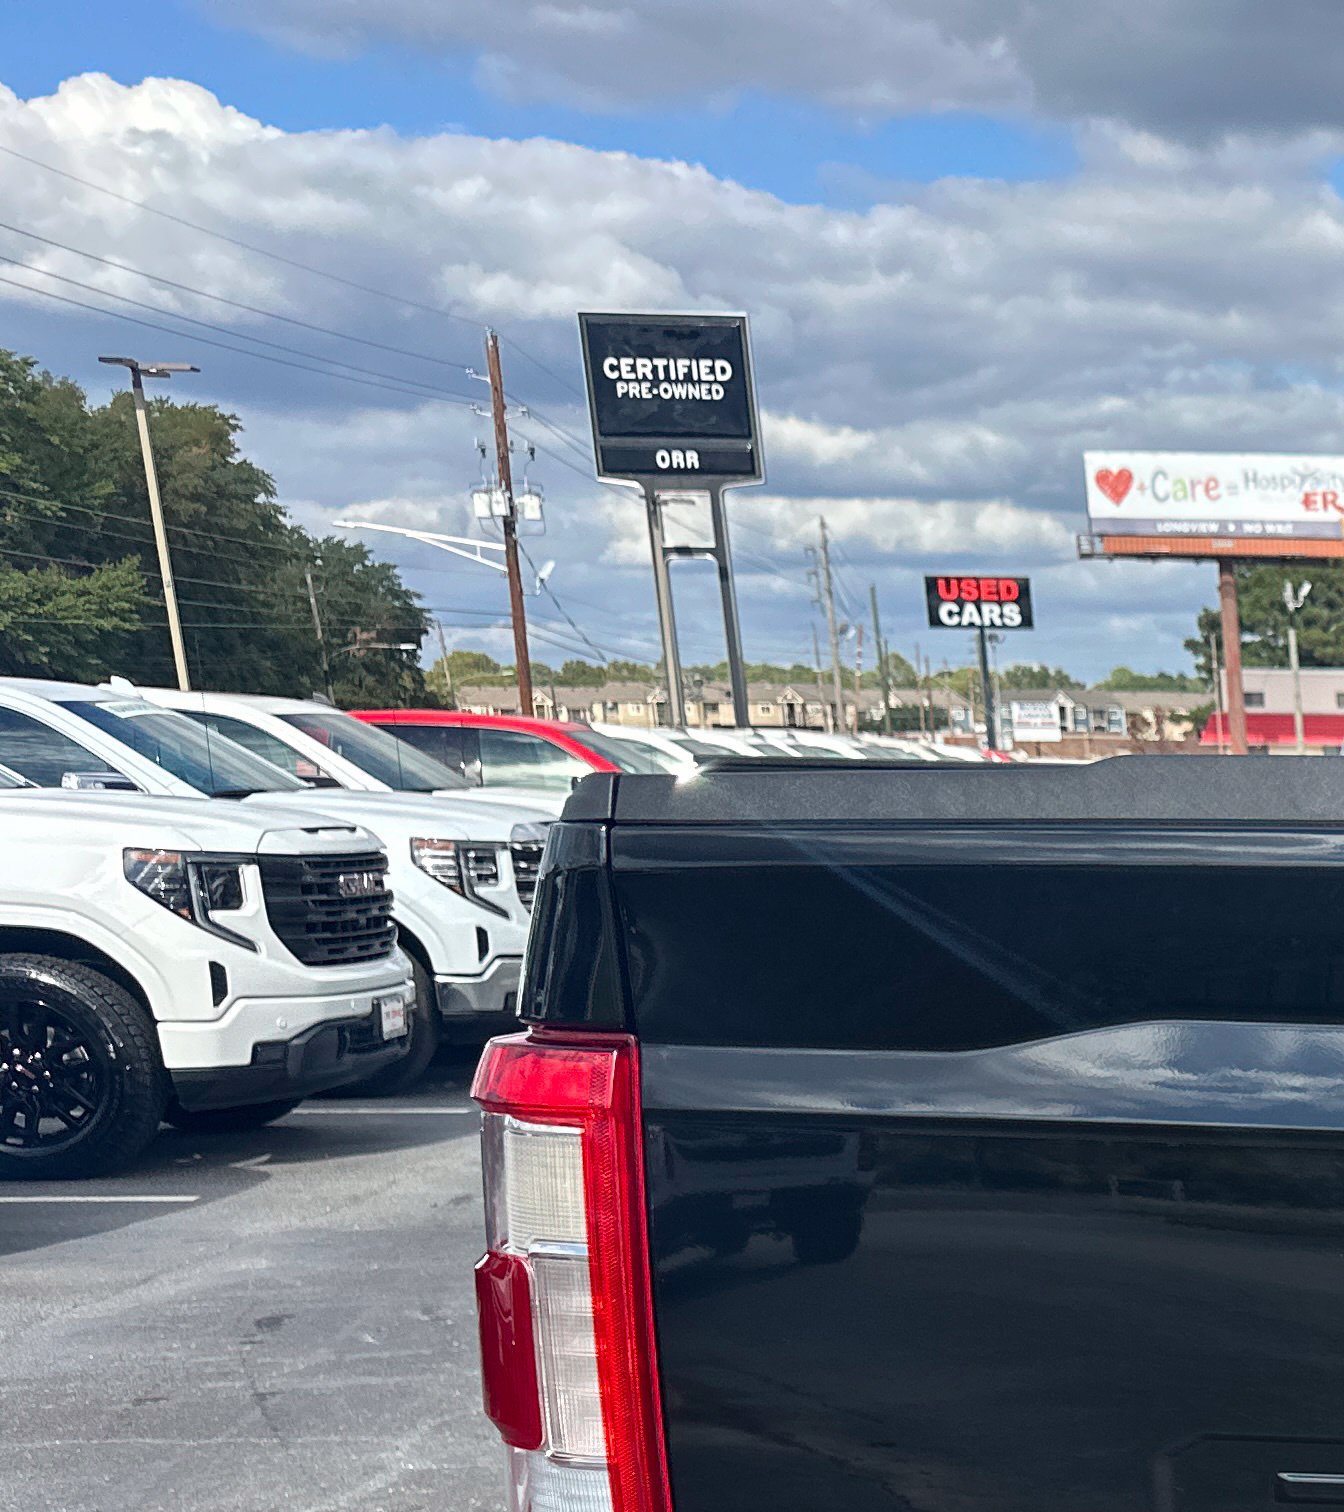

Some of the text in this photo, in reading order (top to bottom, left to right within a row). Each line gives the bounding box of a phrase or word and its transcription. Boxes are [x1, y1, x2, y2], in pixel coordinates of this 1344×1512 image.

[602, 357, 733, 382] CERTIFIED
[616, 381, 725, 400] PRE-OWNED
[655, 449, 700, 469] ORR
[1151, 470, 1222, 502] Care
[1302, 490, 1340, 512] ER
[937, 578, 1019, 601] USED
[938, 602, 1022, 627] CARS
